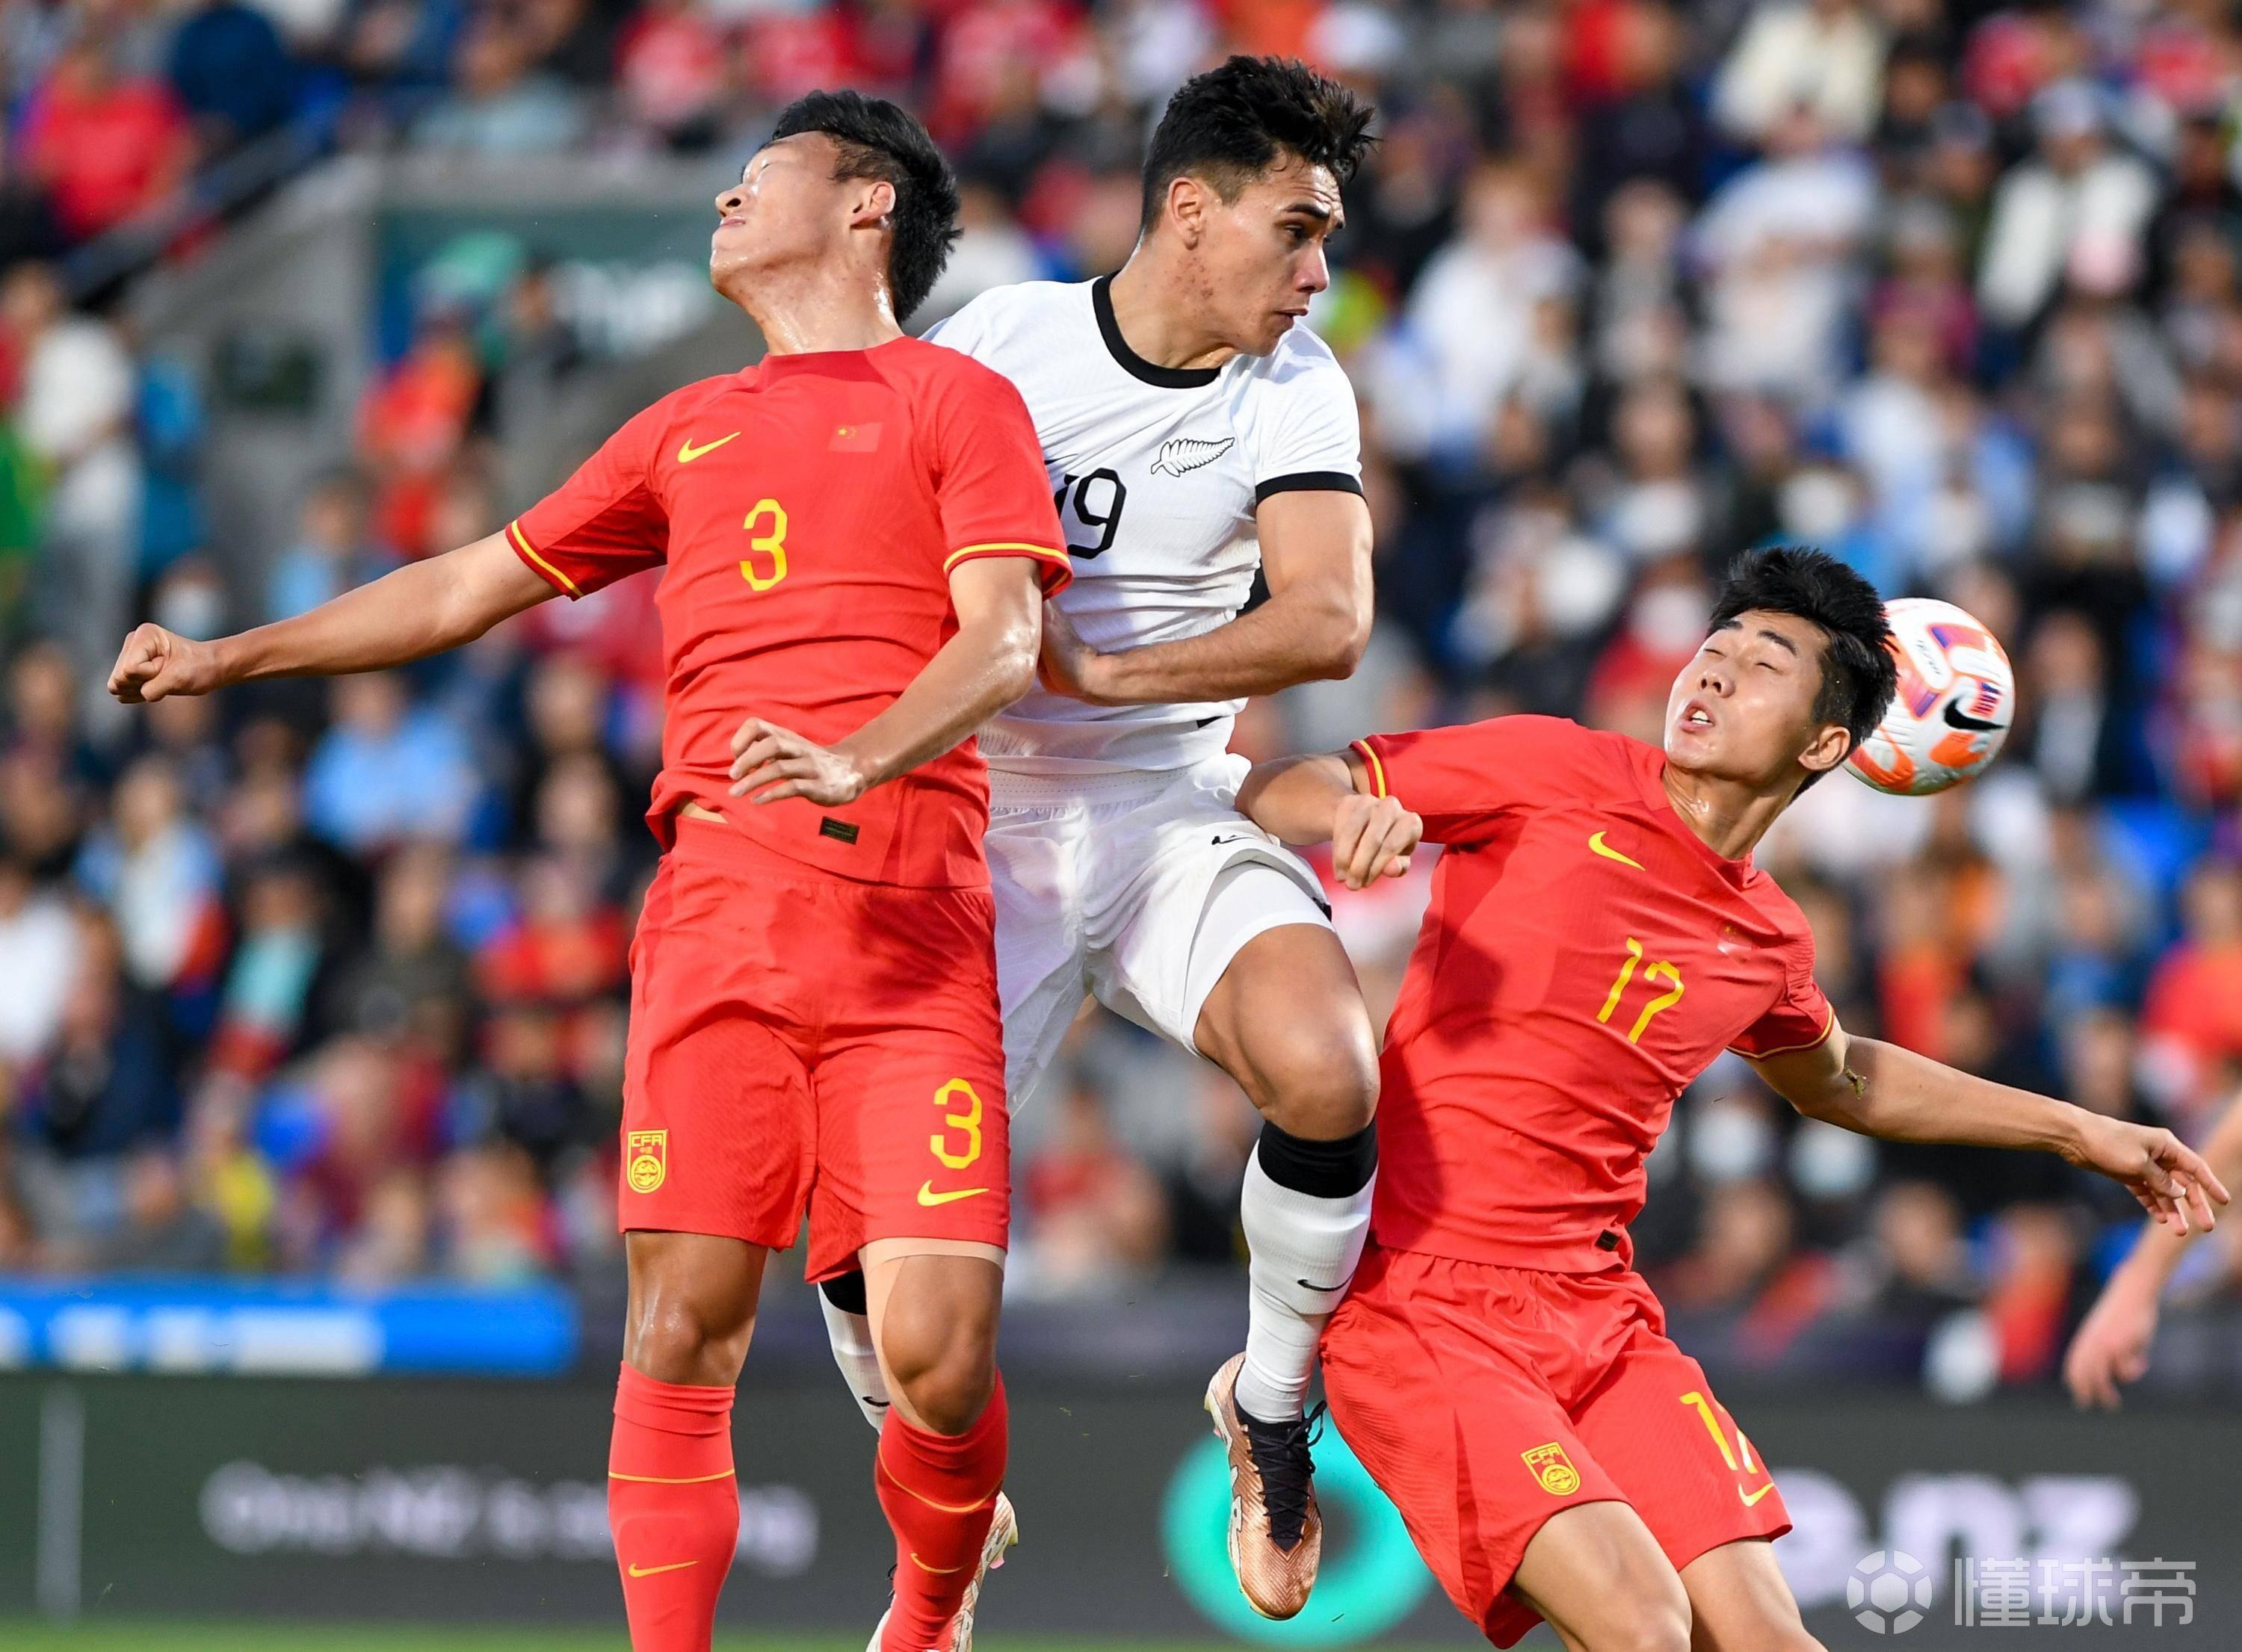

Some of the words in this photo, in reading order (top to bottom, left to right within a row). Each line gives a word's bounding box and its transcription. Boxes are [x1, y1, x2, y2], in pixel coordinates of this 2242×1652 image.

[740, 498, 788, 592] 3
[1596, 937, 1685, 1045] 17
[631, 1135, 663, 1148] CFA
[930, 1077, 983, 1169] 3
[1527, 1447, 1561, 1464] CFA
